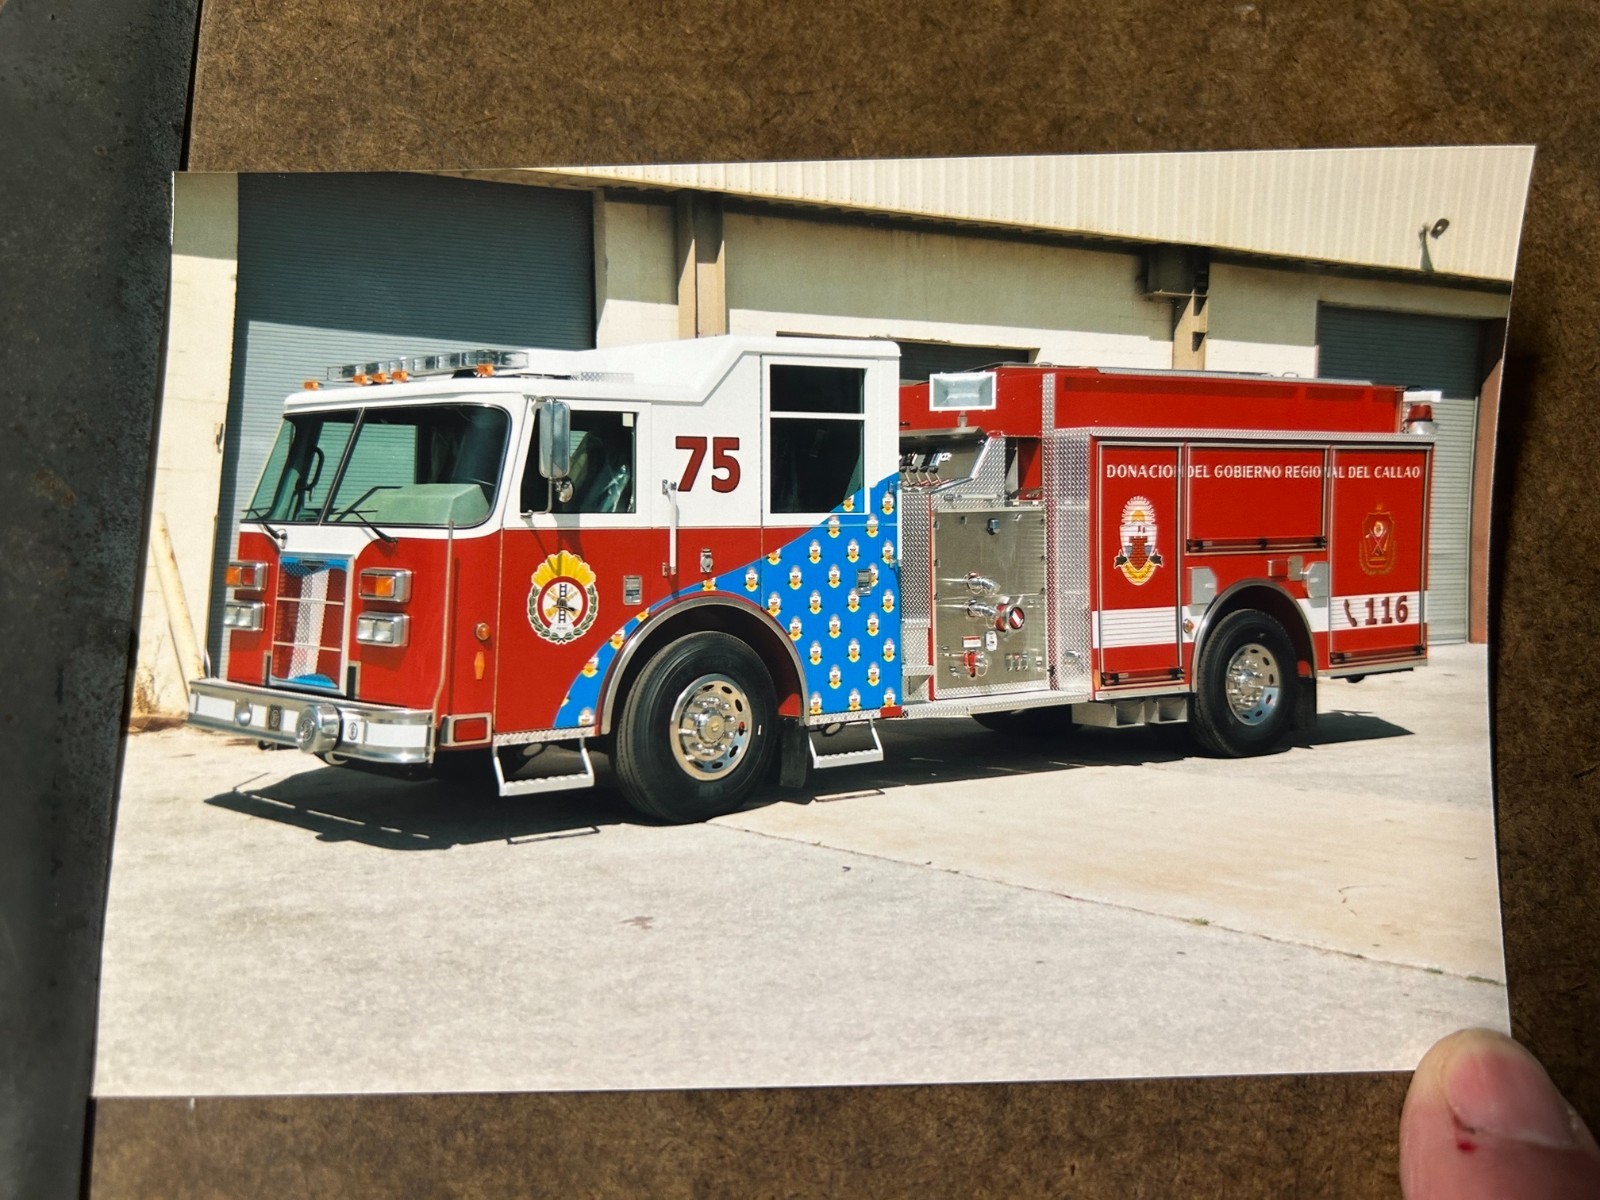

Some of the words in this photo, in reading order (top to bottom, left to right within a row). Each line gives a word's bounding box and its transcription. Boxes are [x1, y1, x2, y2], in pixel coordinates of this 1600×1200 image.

[675, 435, 741, 494] 75
[1186, 464, 1210, 479] DEL
[1214, 464, 1282, 479] GOBIERNO
[1348, 466, 1370, 479] DEL
[1374, 465, 1421, 479] CALLAO
[1365, 594, 1409, 626] 116
